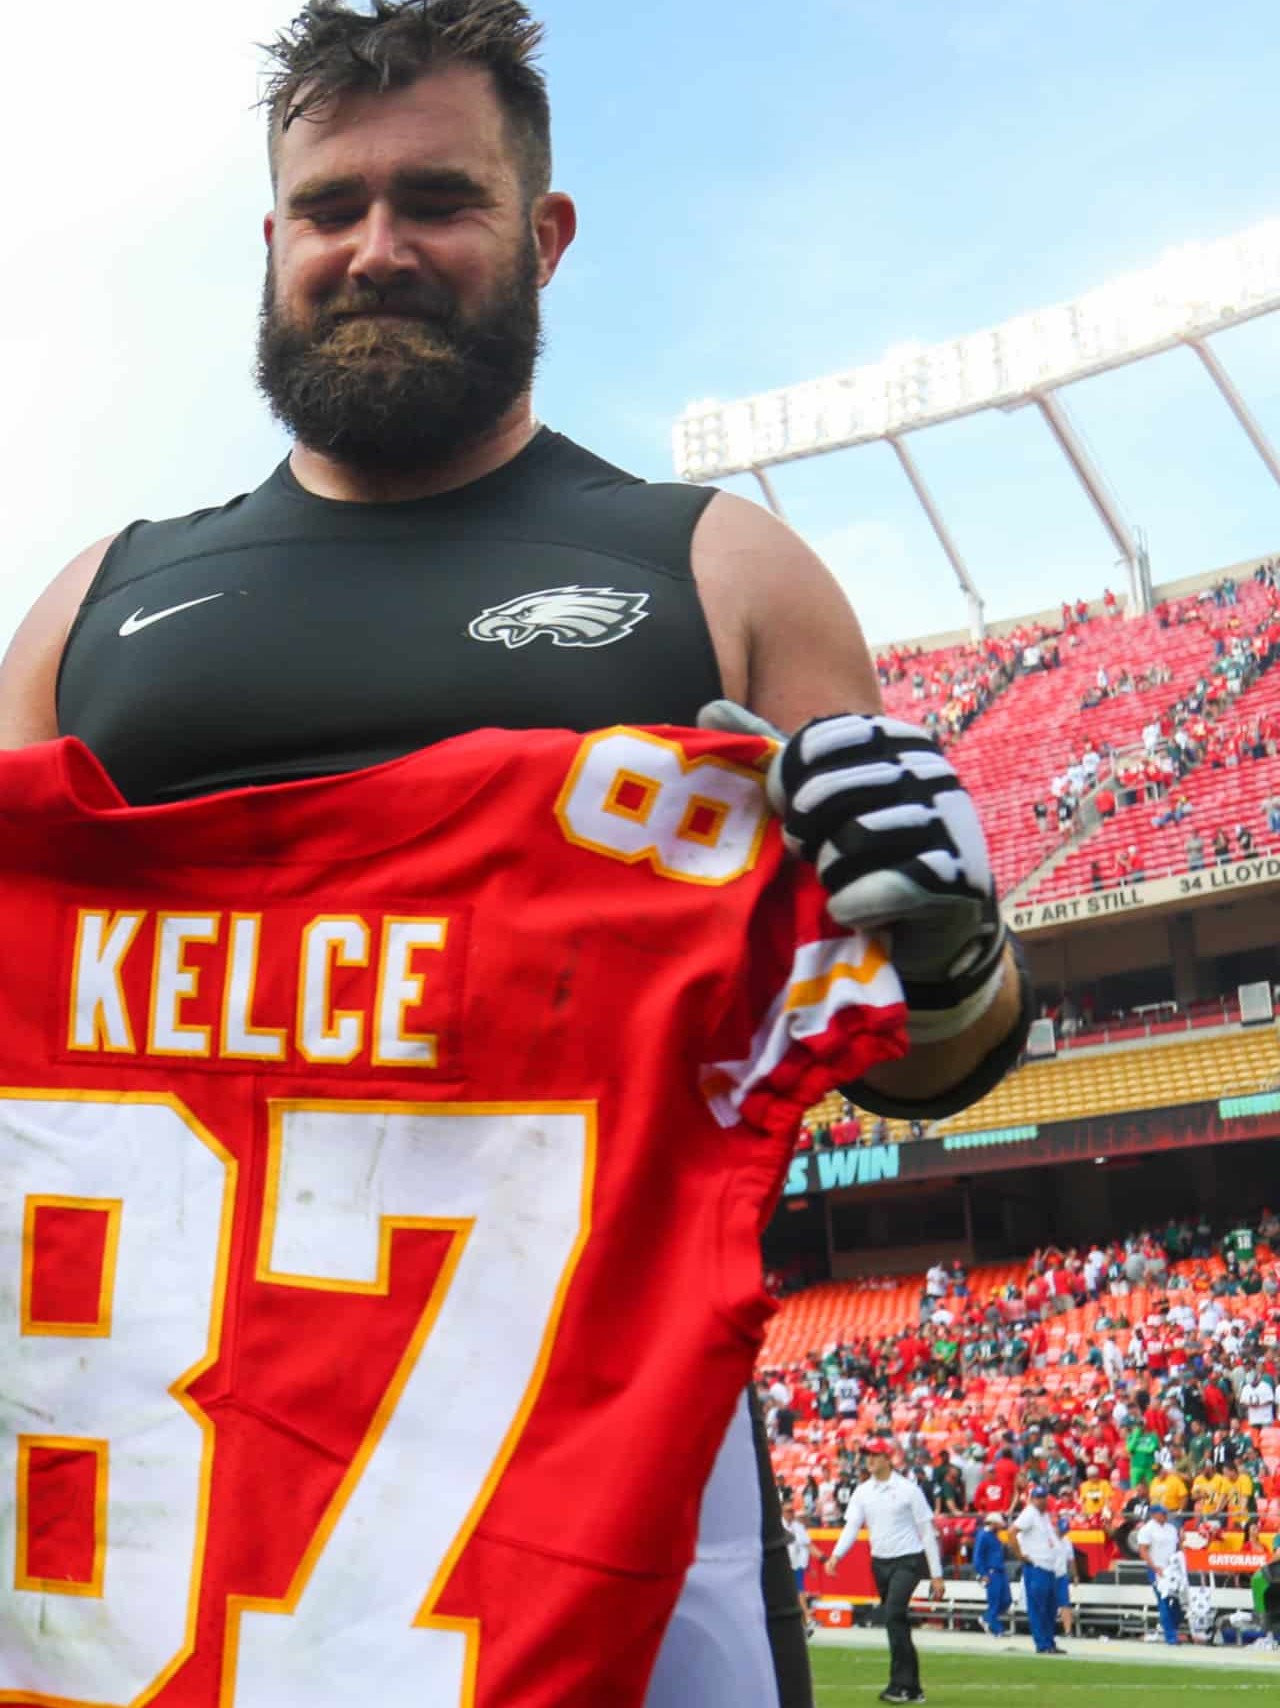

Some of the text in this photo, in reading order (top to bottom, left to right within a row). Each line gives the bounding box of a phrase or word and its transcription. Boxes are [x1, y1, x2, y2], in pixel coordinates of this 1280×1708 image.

[1179, 877, 1203, 894] 34
[1014, 889, 1145, 926] 67 ART STILL
[67, 908, 450, 1070] KELCE
[816, 1143, 900, 1190] WIN
[1207, 1553, 1267, 1567] GATORADE
